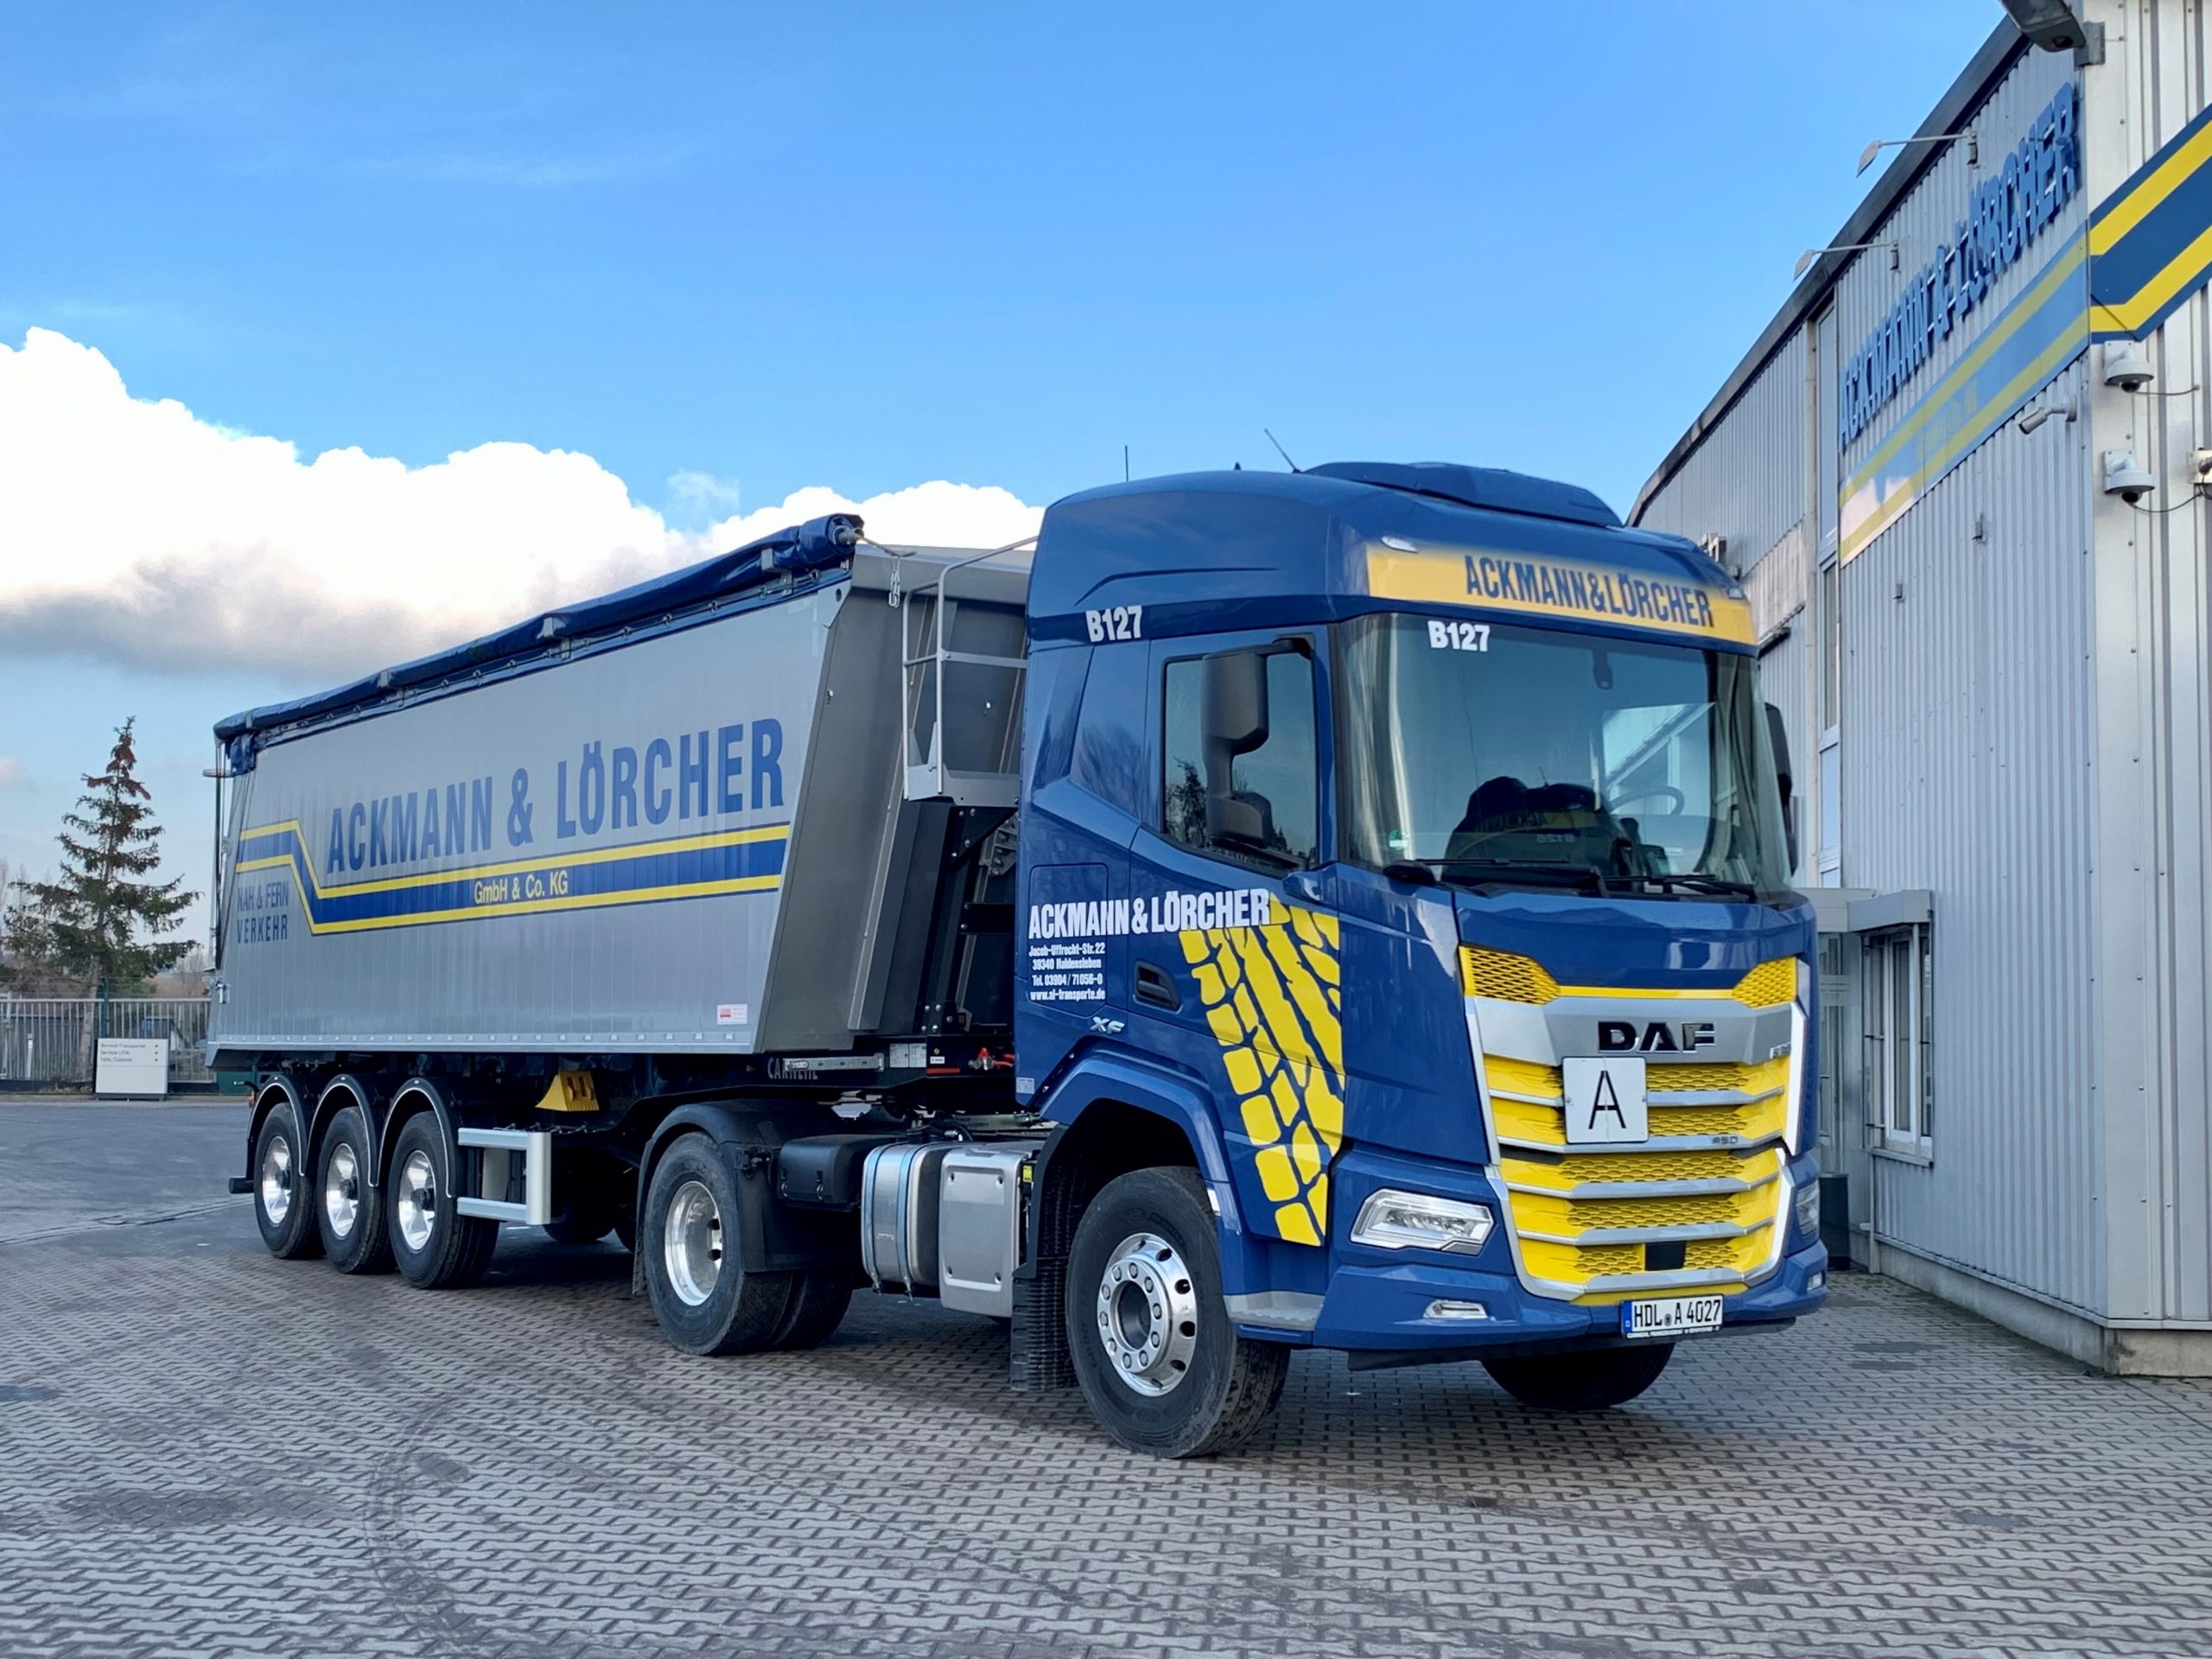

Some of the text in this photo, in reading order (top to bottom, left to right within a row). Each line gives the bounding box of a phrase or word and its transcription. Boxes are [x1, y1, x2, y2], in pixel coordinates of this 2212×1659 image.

[1839, 263, 1928, 454] ACKMANN
[1933, 245, 1950, 340] &
[1085, 605, 1142, 643] B127
[1427, 620, 1491, 652] B127
[327, 718, 784, 874] ACKMANN & LÖRCHER
[237, 886, 256, 912] NAH
[265, 880, 289, 908] FERN
[474, 871, 568, 904] GmbH & Co. KG
[237, 914, 288, 944] VERKEHR
[1033, 957, 1102, 970] 39340 Haldensleben
[1090, 1016, 1125, 1034] XF
[1598, 1021, 1715, 1053] DAF
[1588, 1070, 1626, 1129] A
[1634, 1300, 1720, 1328] HDL A 4027
